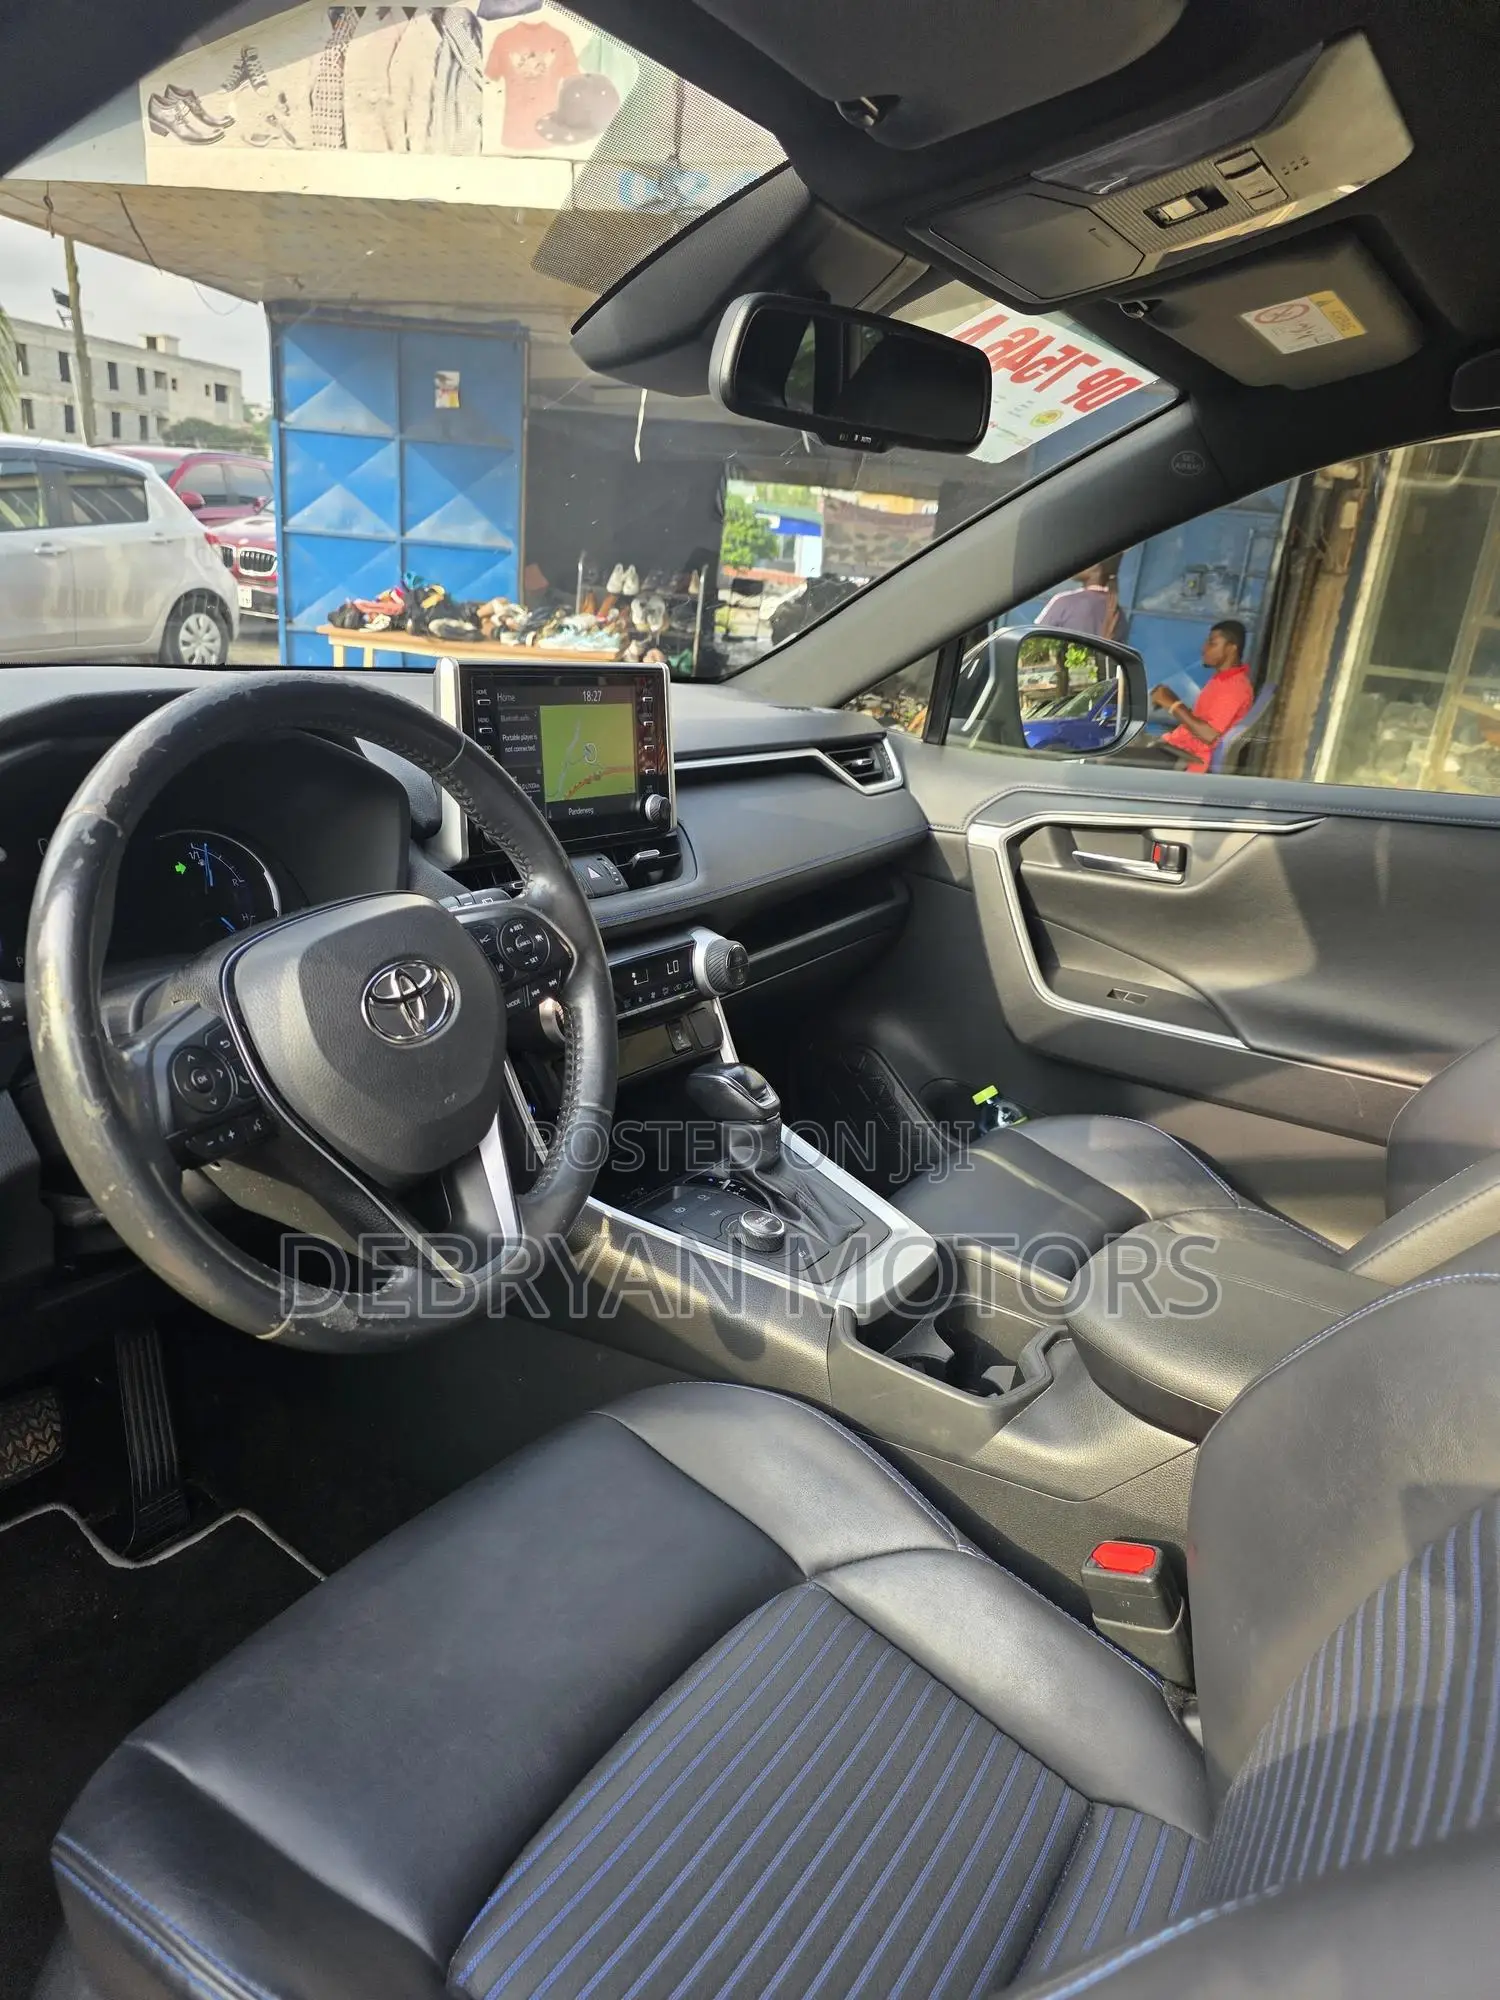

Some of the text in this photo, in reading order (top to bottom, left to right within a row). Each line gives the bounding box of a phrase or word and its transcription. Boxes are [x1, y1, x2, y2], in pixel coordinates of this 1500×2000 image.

[496, 692, 516, 702] Home
[583, 690, 602, 702] 18:27
[506, 998, 521, 1009] MODE
